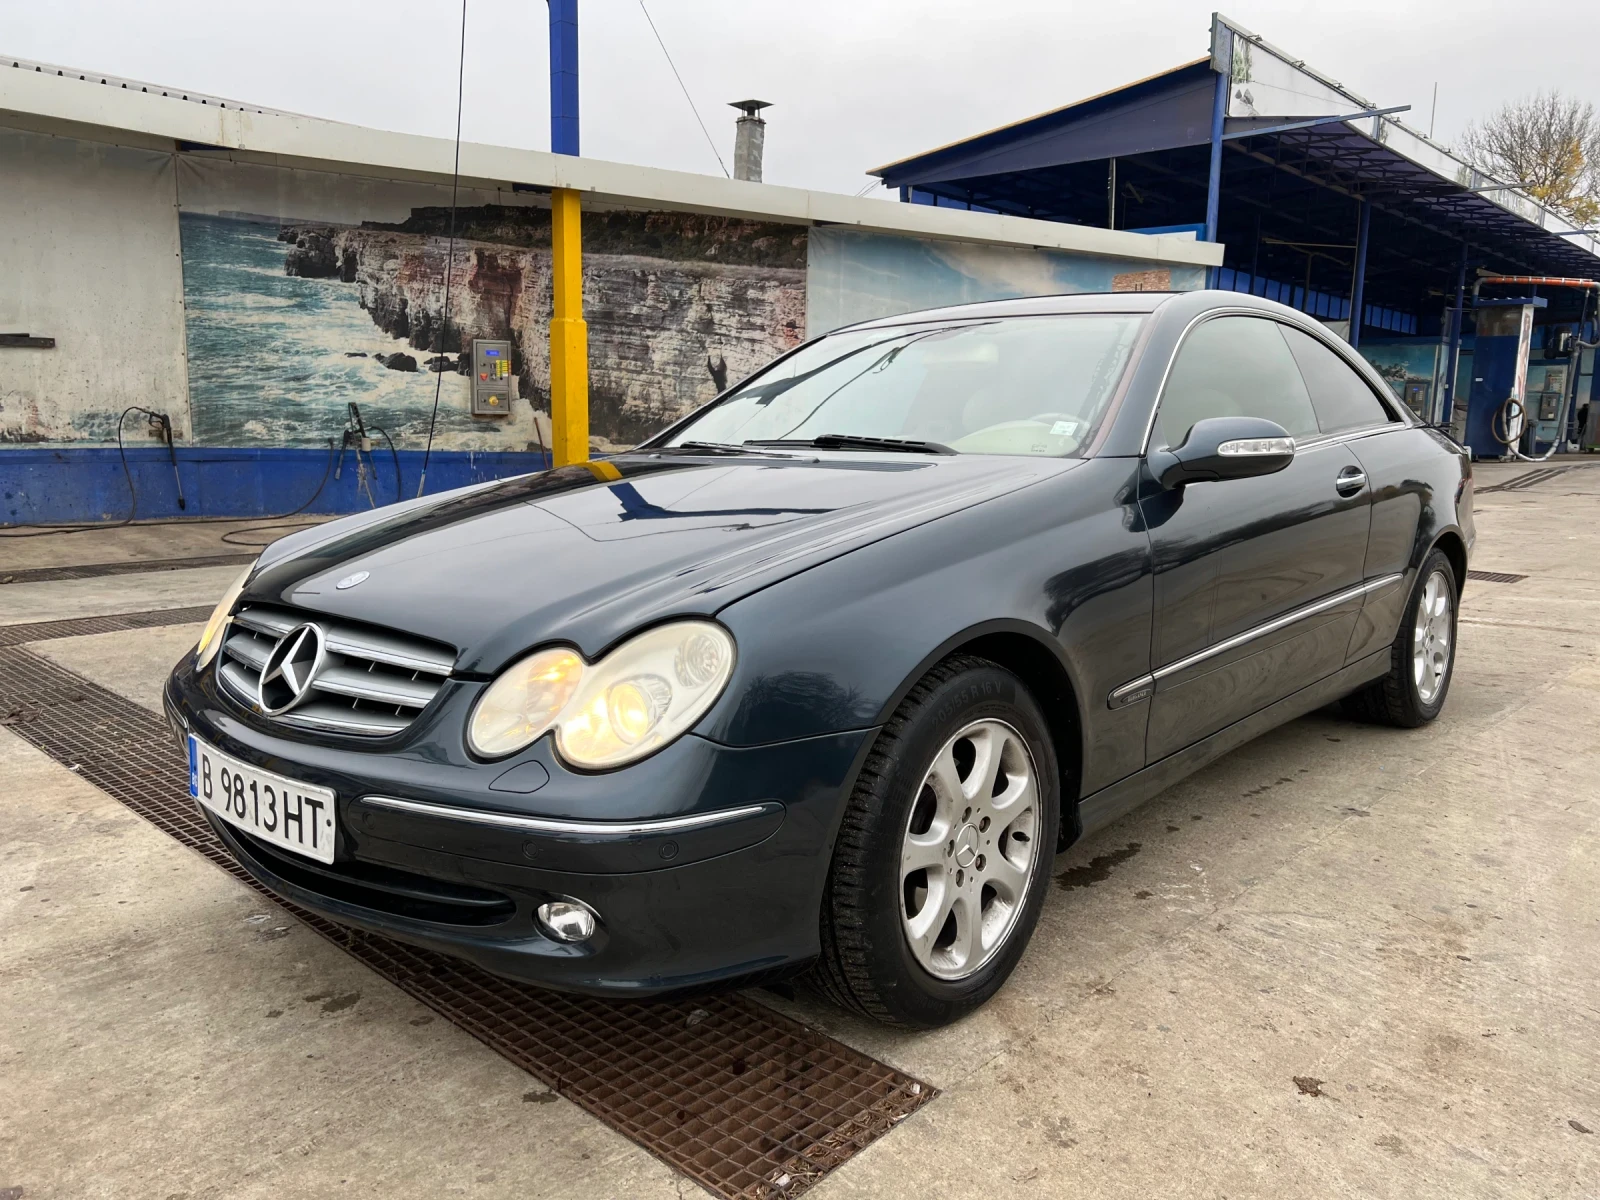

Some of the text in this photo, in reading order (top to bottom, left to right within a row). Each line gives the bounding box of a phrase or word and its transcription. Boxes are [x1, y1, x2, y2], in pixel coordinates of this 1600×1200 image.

[931, 689, 969, 732] 205/55
[981, 680, 992, 695] 16
[202, 753, 213, 800] B
